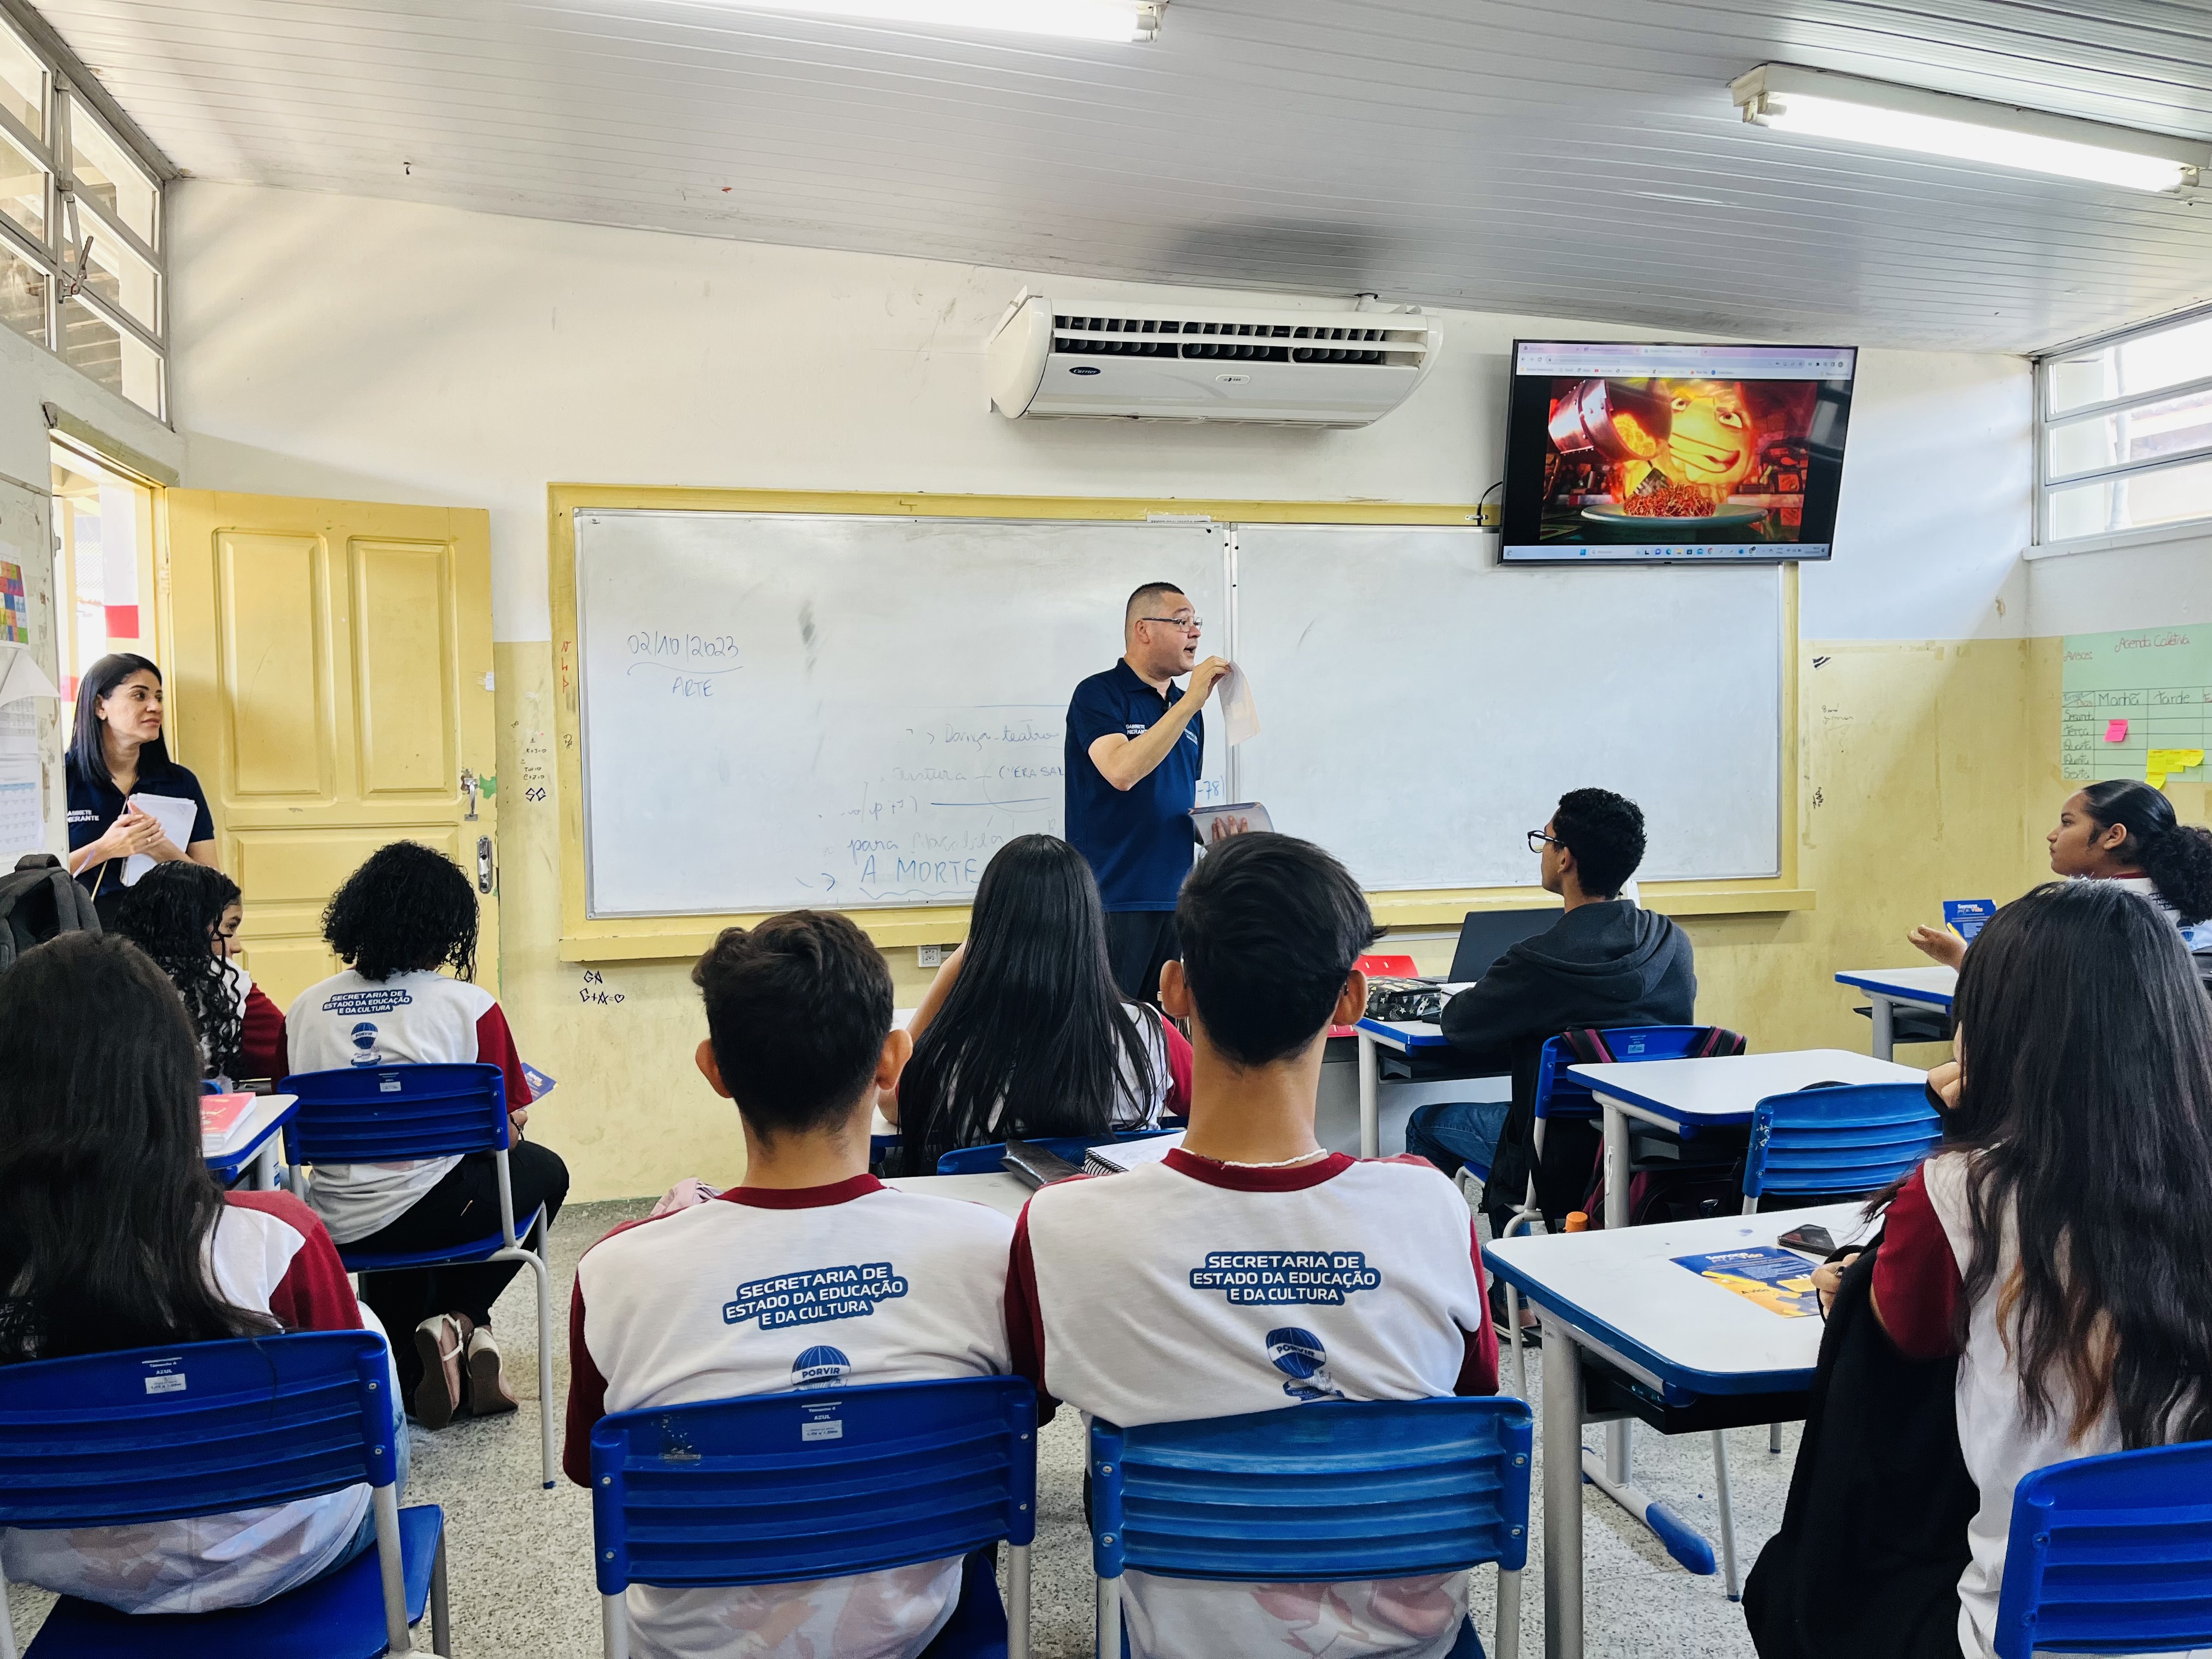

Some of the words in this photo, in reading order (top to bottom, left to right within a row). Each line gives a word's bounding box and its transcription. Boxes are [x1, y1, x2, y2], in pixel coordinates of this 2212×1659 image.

[628, 631, 739, 662] 02/10/2023
[2114, 634, 2151, 652] Agenda
[673, 676, 714, 697] ARTE
[2098, 692, 2141, 706] Manhã
[847, 837, 899, 865] para
[861, 855, 877, 884] A
[896, 856, 980, 885] MORTE
[324, 1001, 354, 1009] ESTADO
[368, 997, 410, 1005] EDUCAÇÃO
[331, 992, 388, 1002] SECRETARIA
[1208, 1255, 1329, 1268] SECRETARIA
[1333, 1256, 1359, 1268] DE
[740, 1269, 858, 1300] SECRETARIA
[862, 1266, 888, 1280] DE
[1193, 1272, 1258, 1285] ESTADO
[1262, 1272, 1285, 1284] DA
[1289, 1270, 1375, 1289] EDUCAÇÃO
[725, 1294, 789, 1319] ESTADO
[793, 1292, 816, 1305] DA
[819, 1280, 903, 1301] EDUCAÇÃO
[1230, 1288, 1240, 1300] E
[1243, 1288, 1266, 1301] DA
[1268, 1288, 1339, 1301] CULTURA
[761, 1312, 771, 1325] E
[775, 1310, 797, 1323] DA
[799, 1300, 868, 1320] CULTURA
[1276, 1344, 1315, 1358] PORVIR
[802, 1366, 840, 1379] PORVIR
